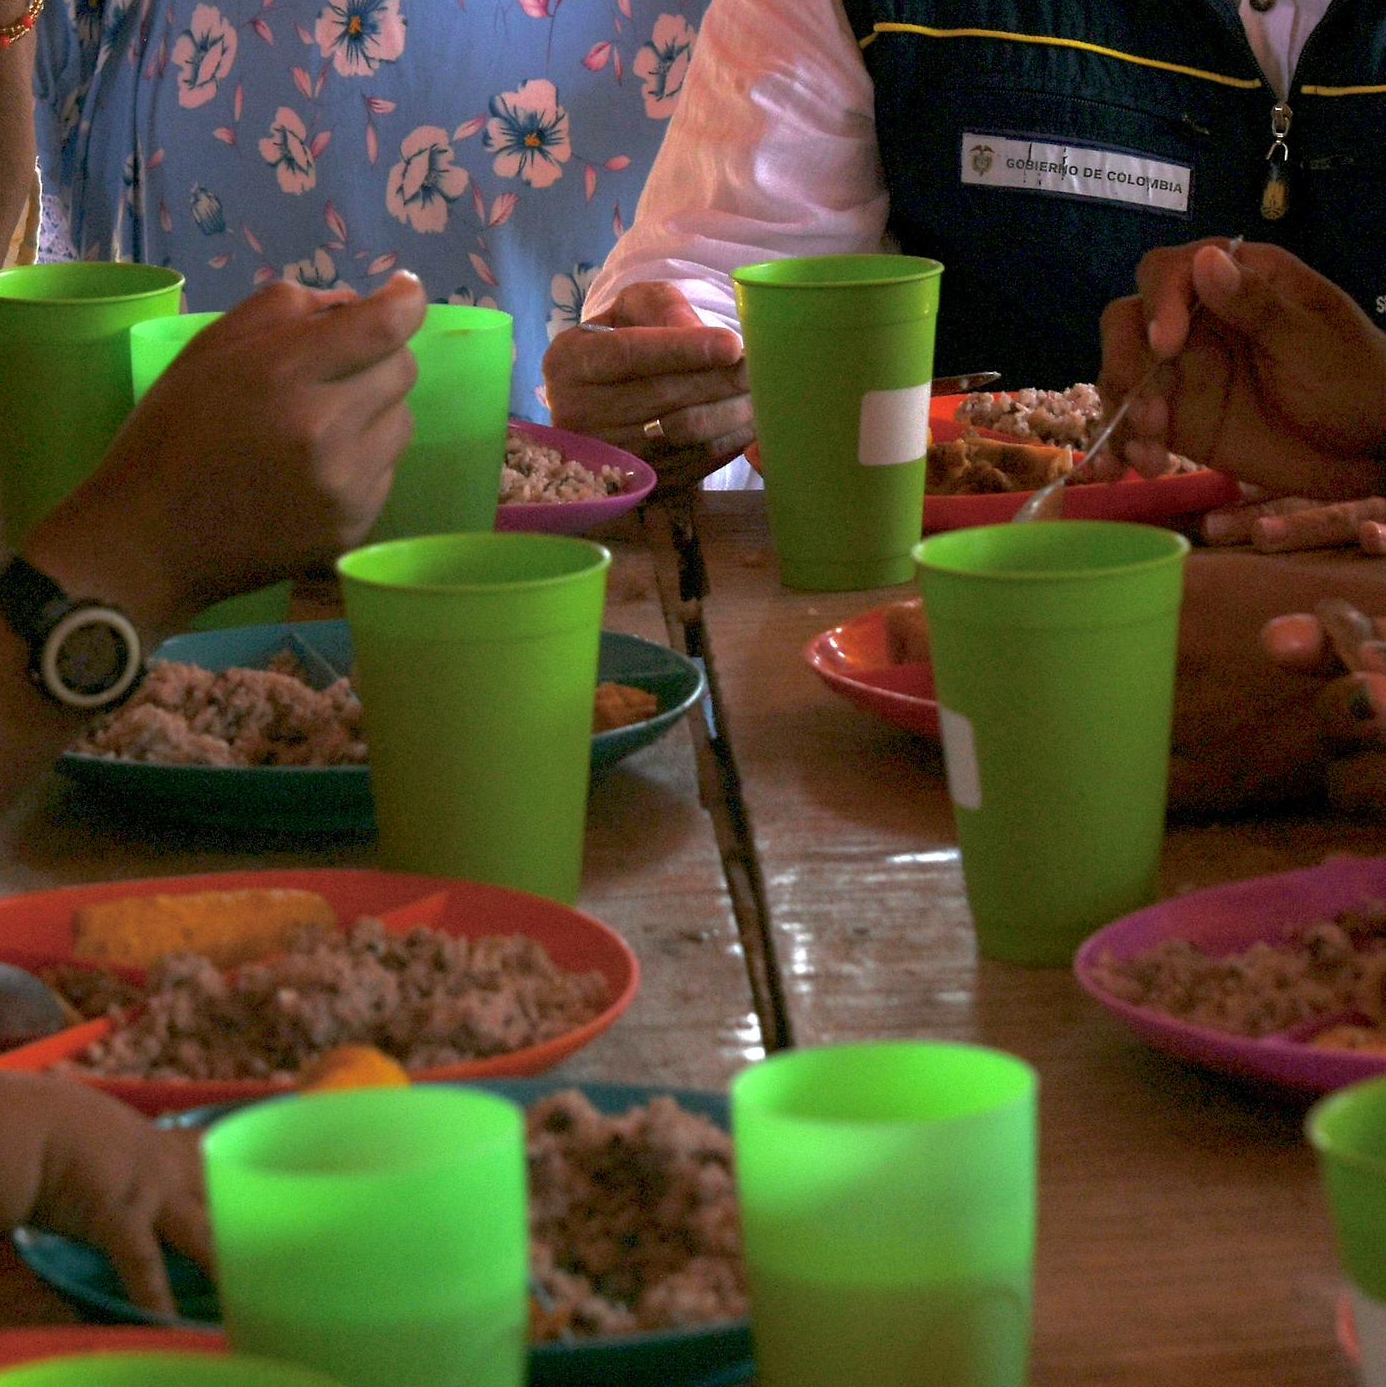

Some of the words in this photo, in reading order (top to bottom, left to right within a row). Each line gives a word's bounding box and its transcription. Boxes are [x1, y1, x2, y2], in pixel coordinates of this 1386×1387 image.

[1006, 158, 1078, 176] GOBIERNO
[1083, 167, 1102, 180] DE
[1107, 171, 1183, 194] COLOMBIA
